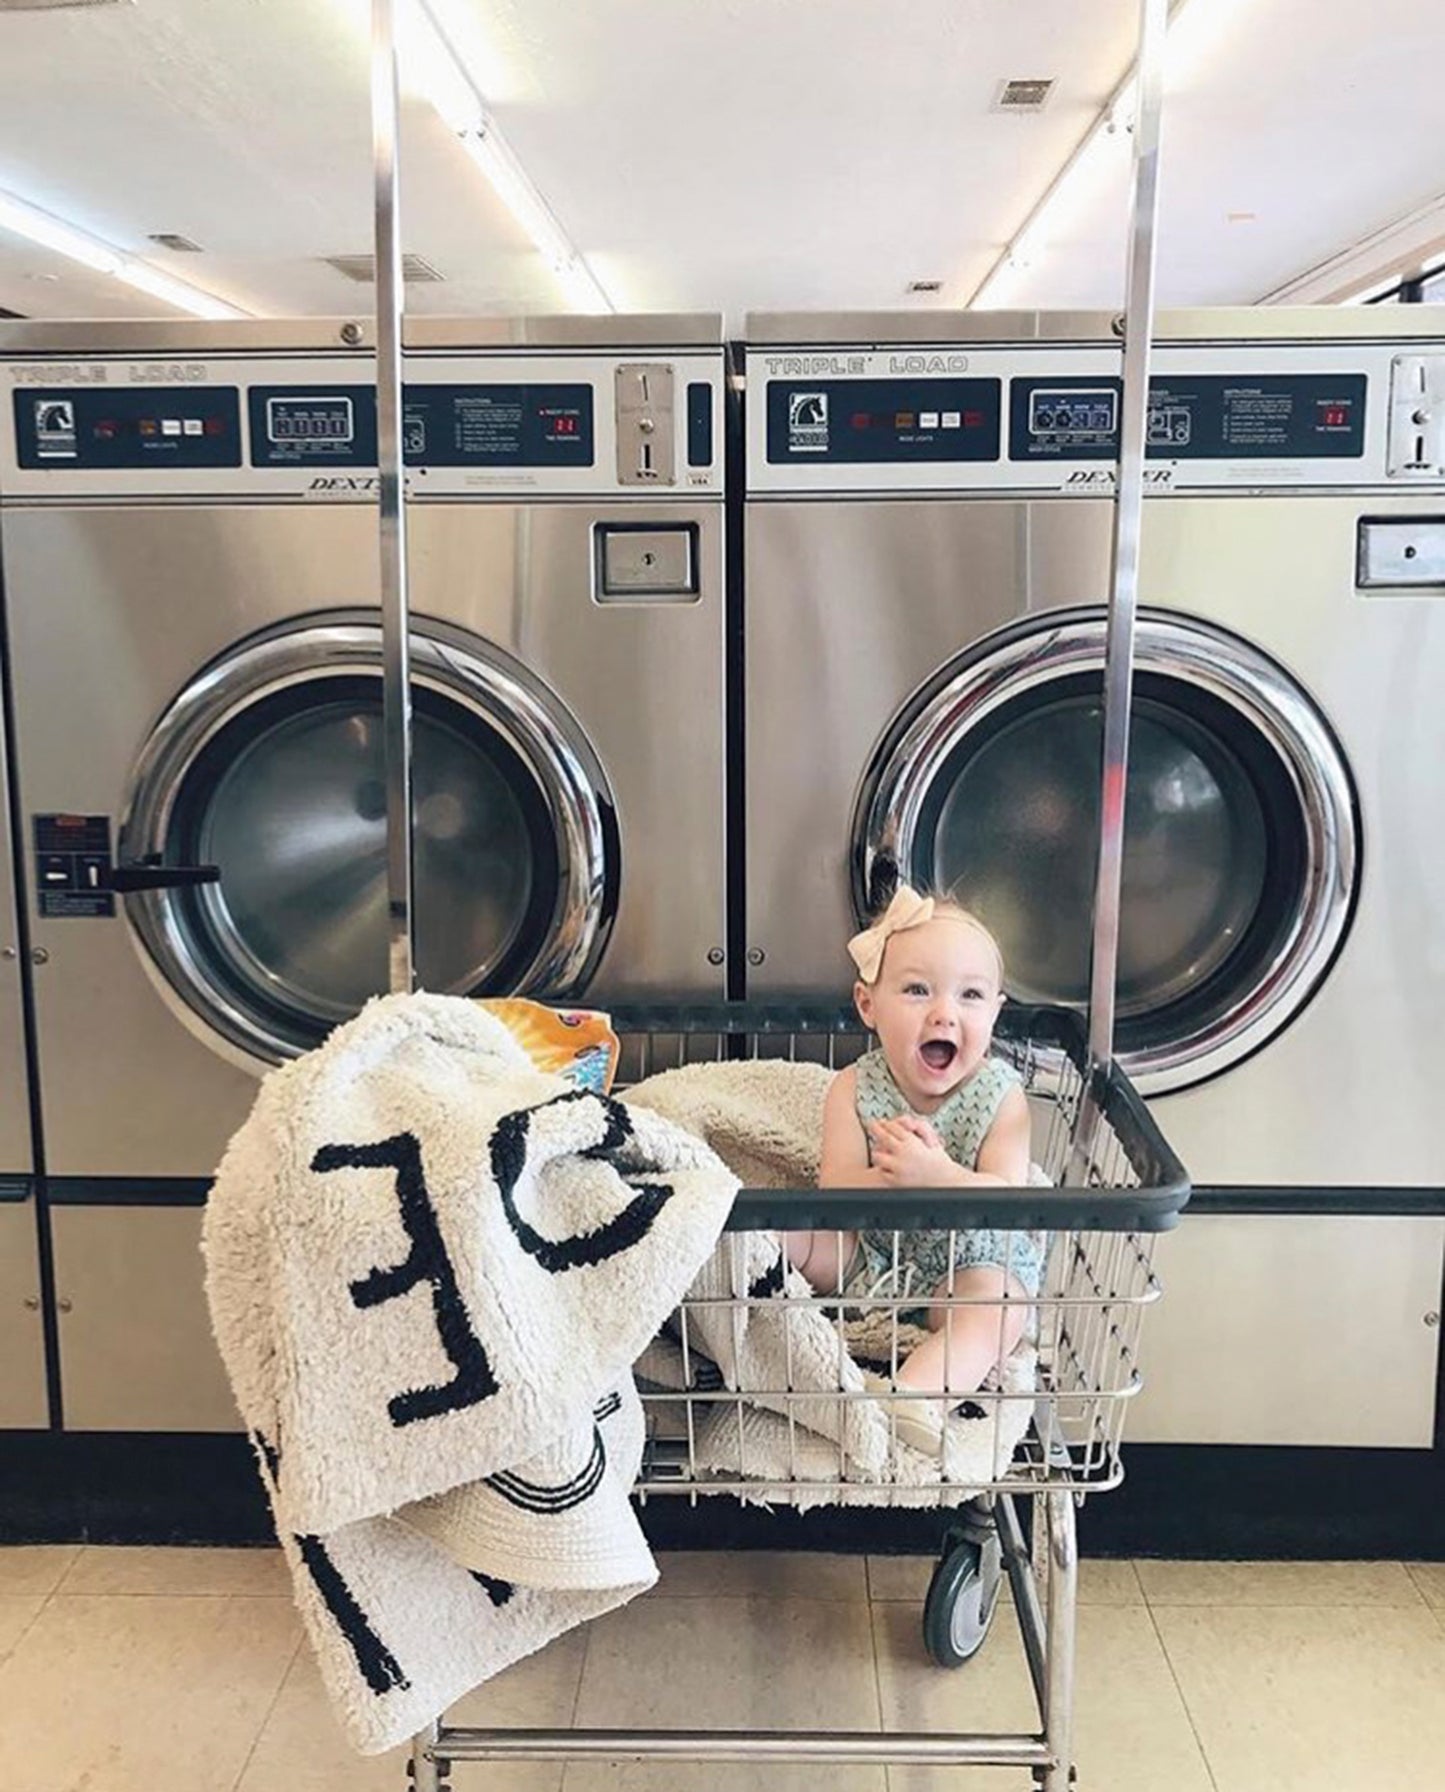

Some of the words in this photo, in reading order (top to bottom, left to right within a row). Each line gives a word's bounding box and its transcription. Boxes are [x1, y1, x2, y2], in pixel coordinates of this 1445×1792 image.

[9, 364, 108, 383] TRIPLE
[129, 364, 207, 383] LOAD
[765, 356, 865, 375] TRIPLE
[888, 355, 969, 374] LOAD
